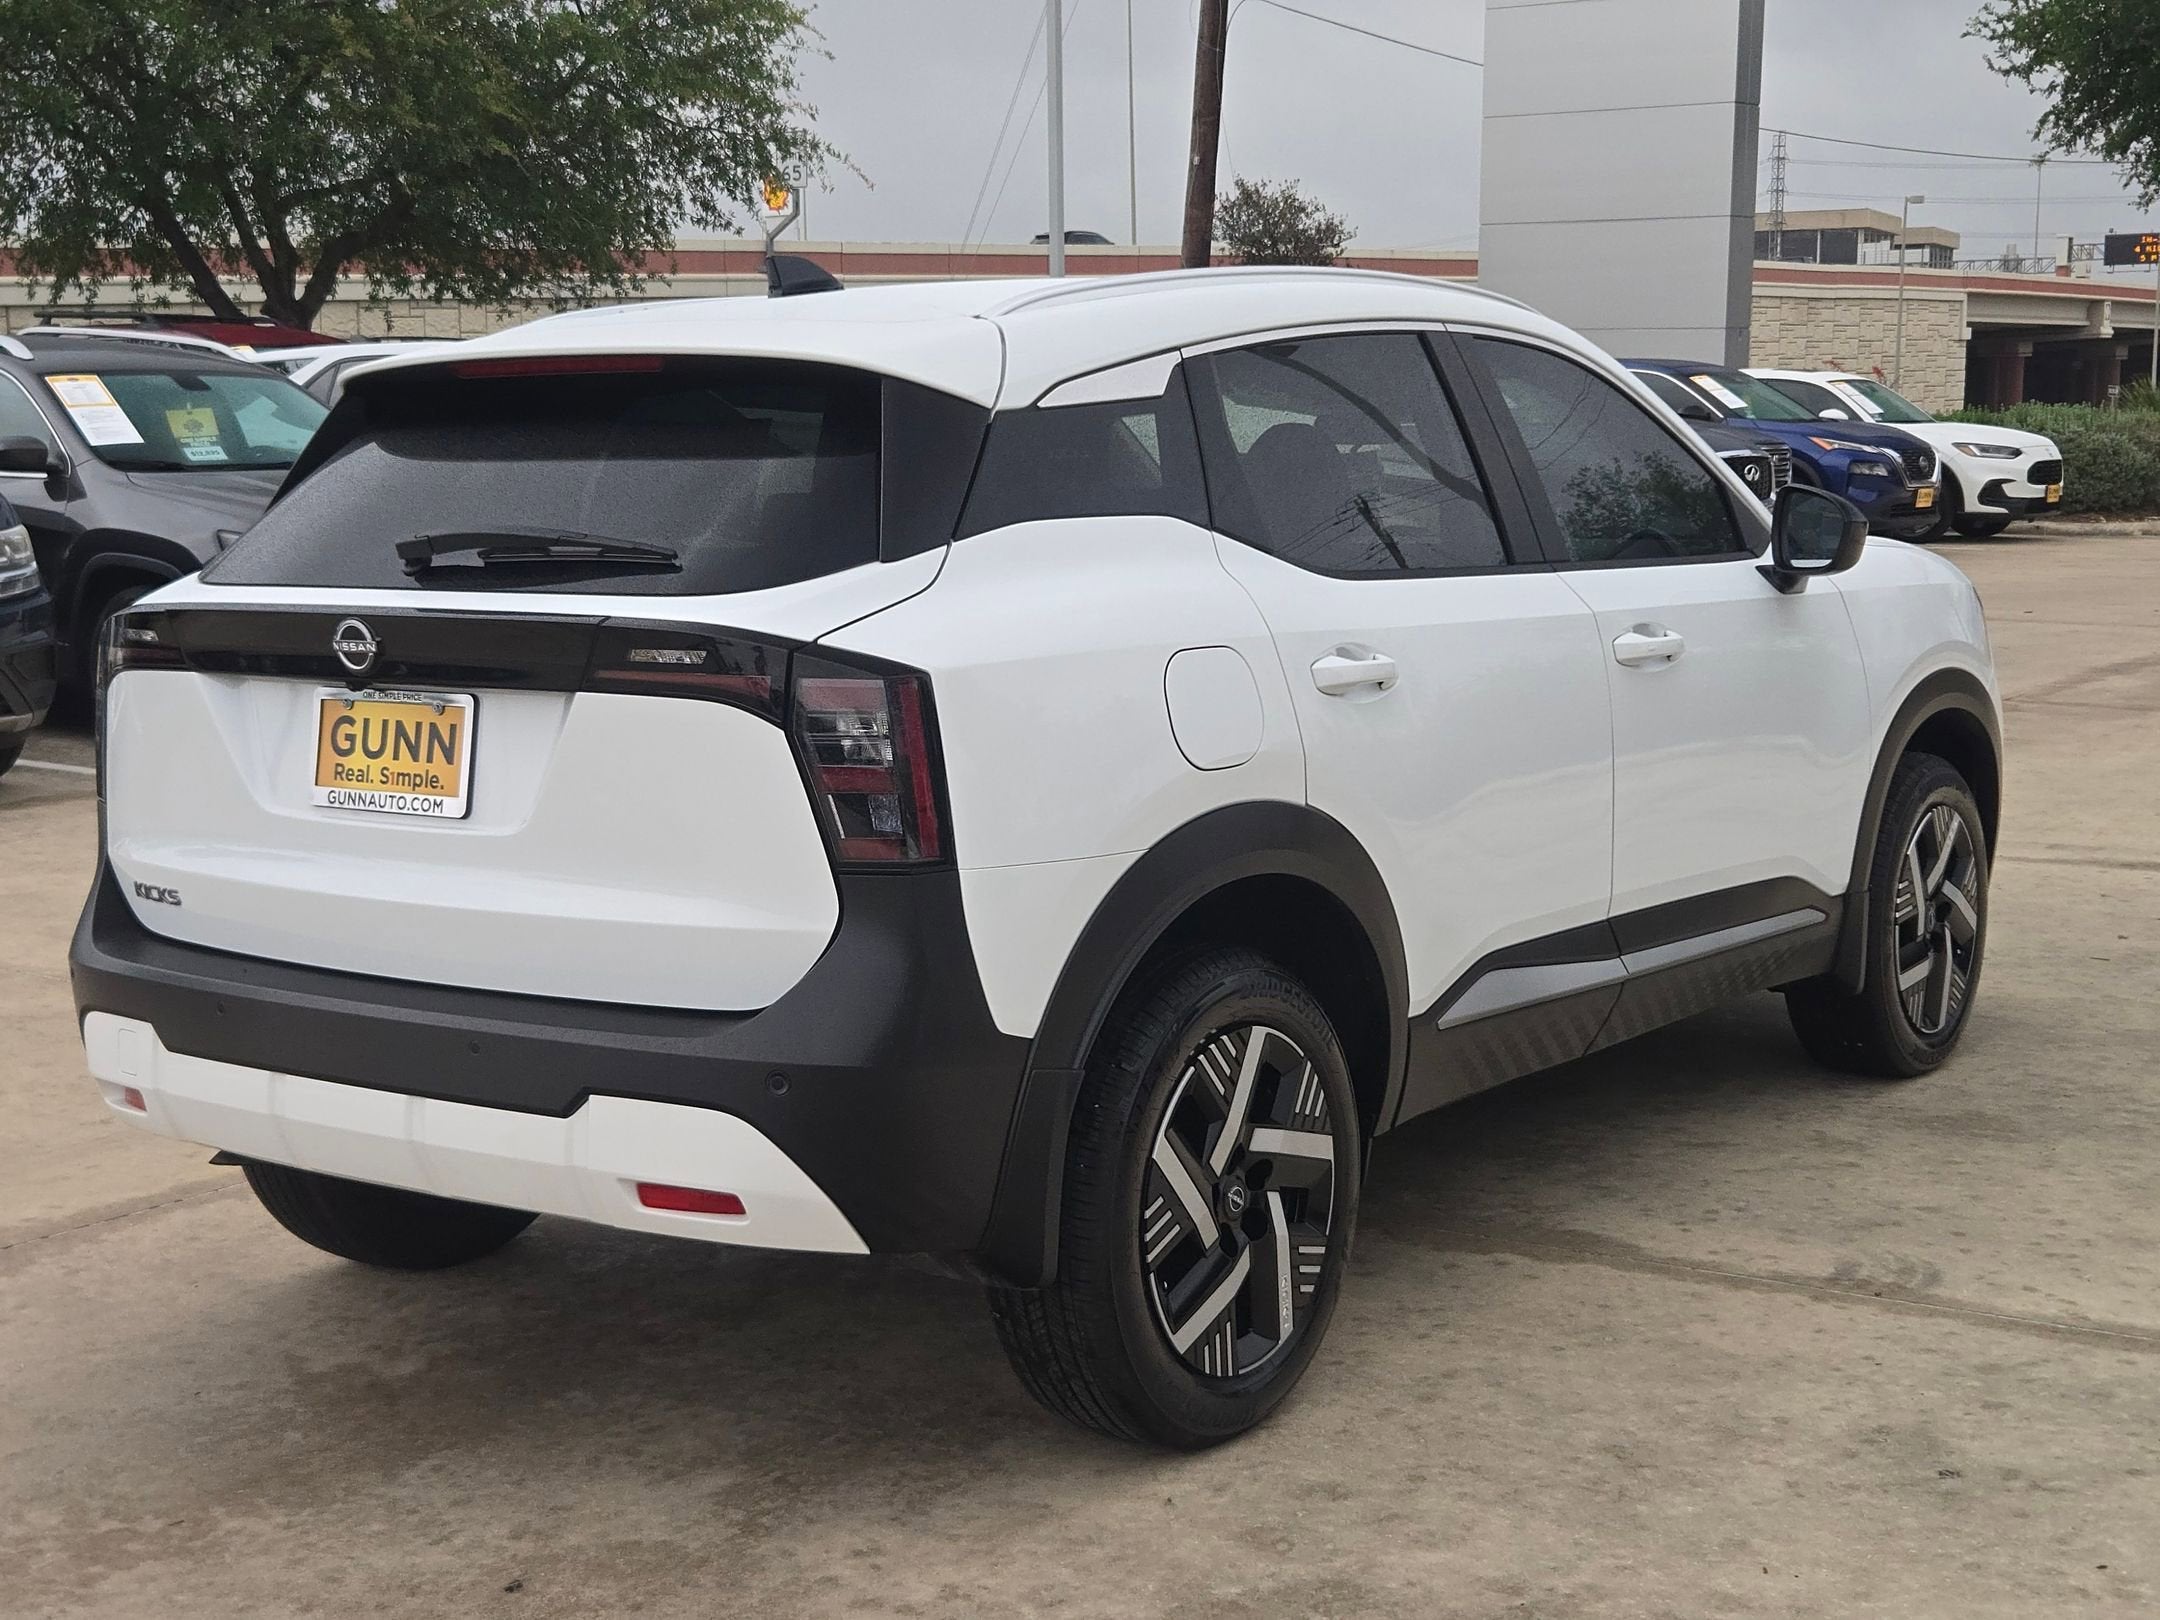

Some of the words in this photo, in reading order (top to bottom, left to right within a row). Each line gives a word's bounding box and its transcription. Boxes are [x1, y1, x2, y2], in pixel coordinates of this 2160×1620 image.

[333, 641, 377, 652] NISSAN
[362, 691, 377, 700] ONE
[378, 692, 401, 701] SIMPLE
[402, 693, 422, 702] PRICE
[330, 715, 458, 766] GUNN
[334, 763, 374, 784] Real.
[327, 790, 444, 814] GUNNAUTO.COM
[133, 880, 182, 906] KICKS
